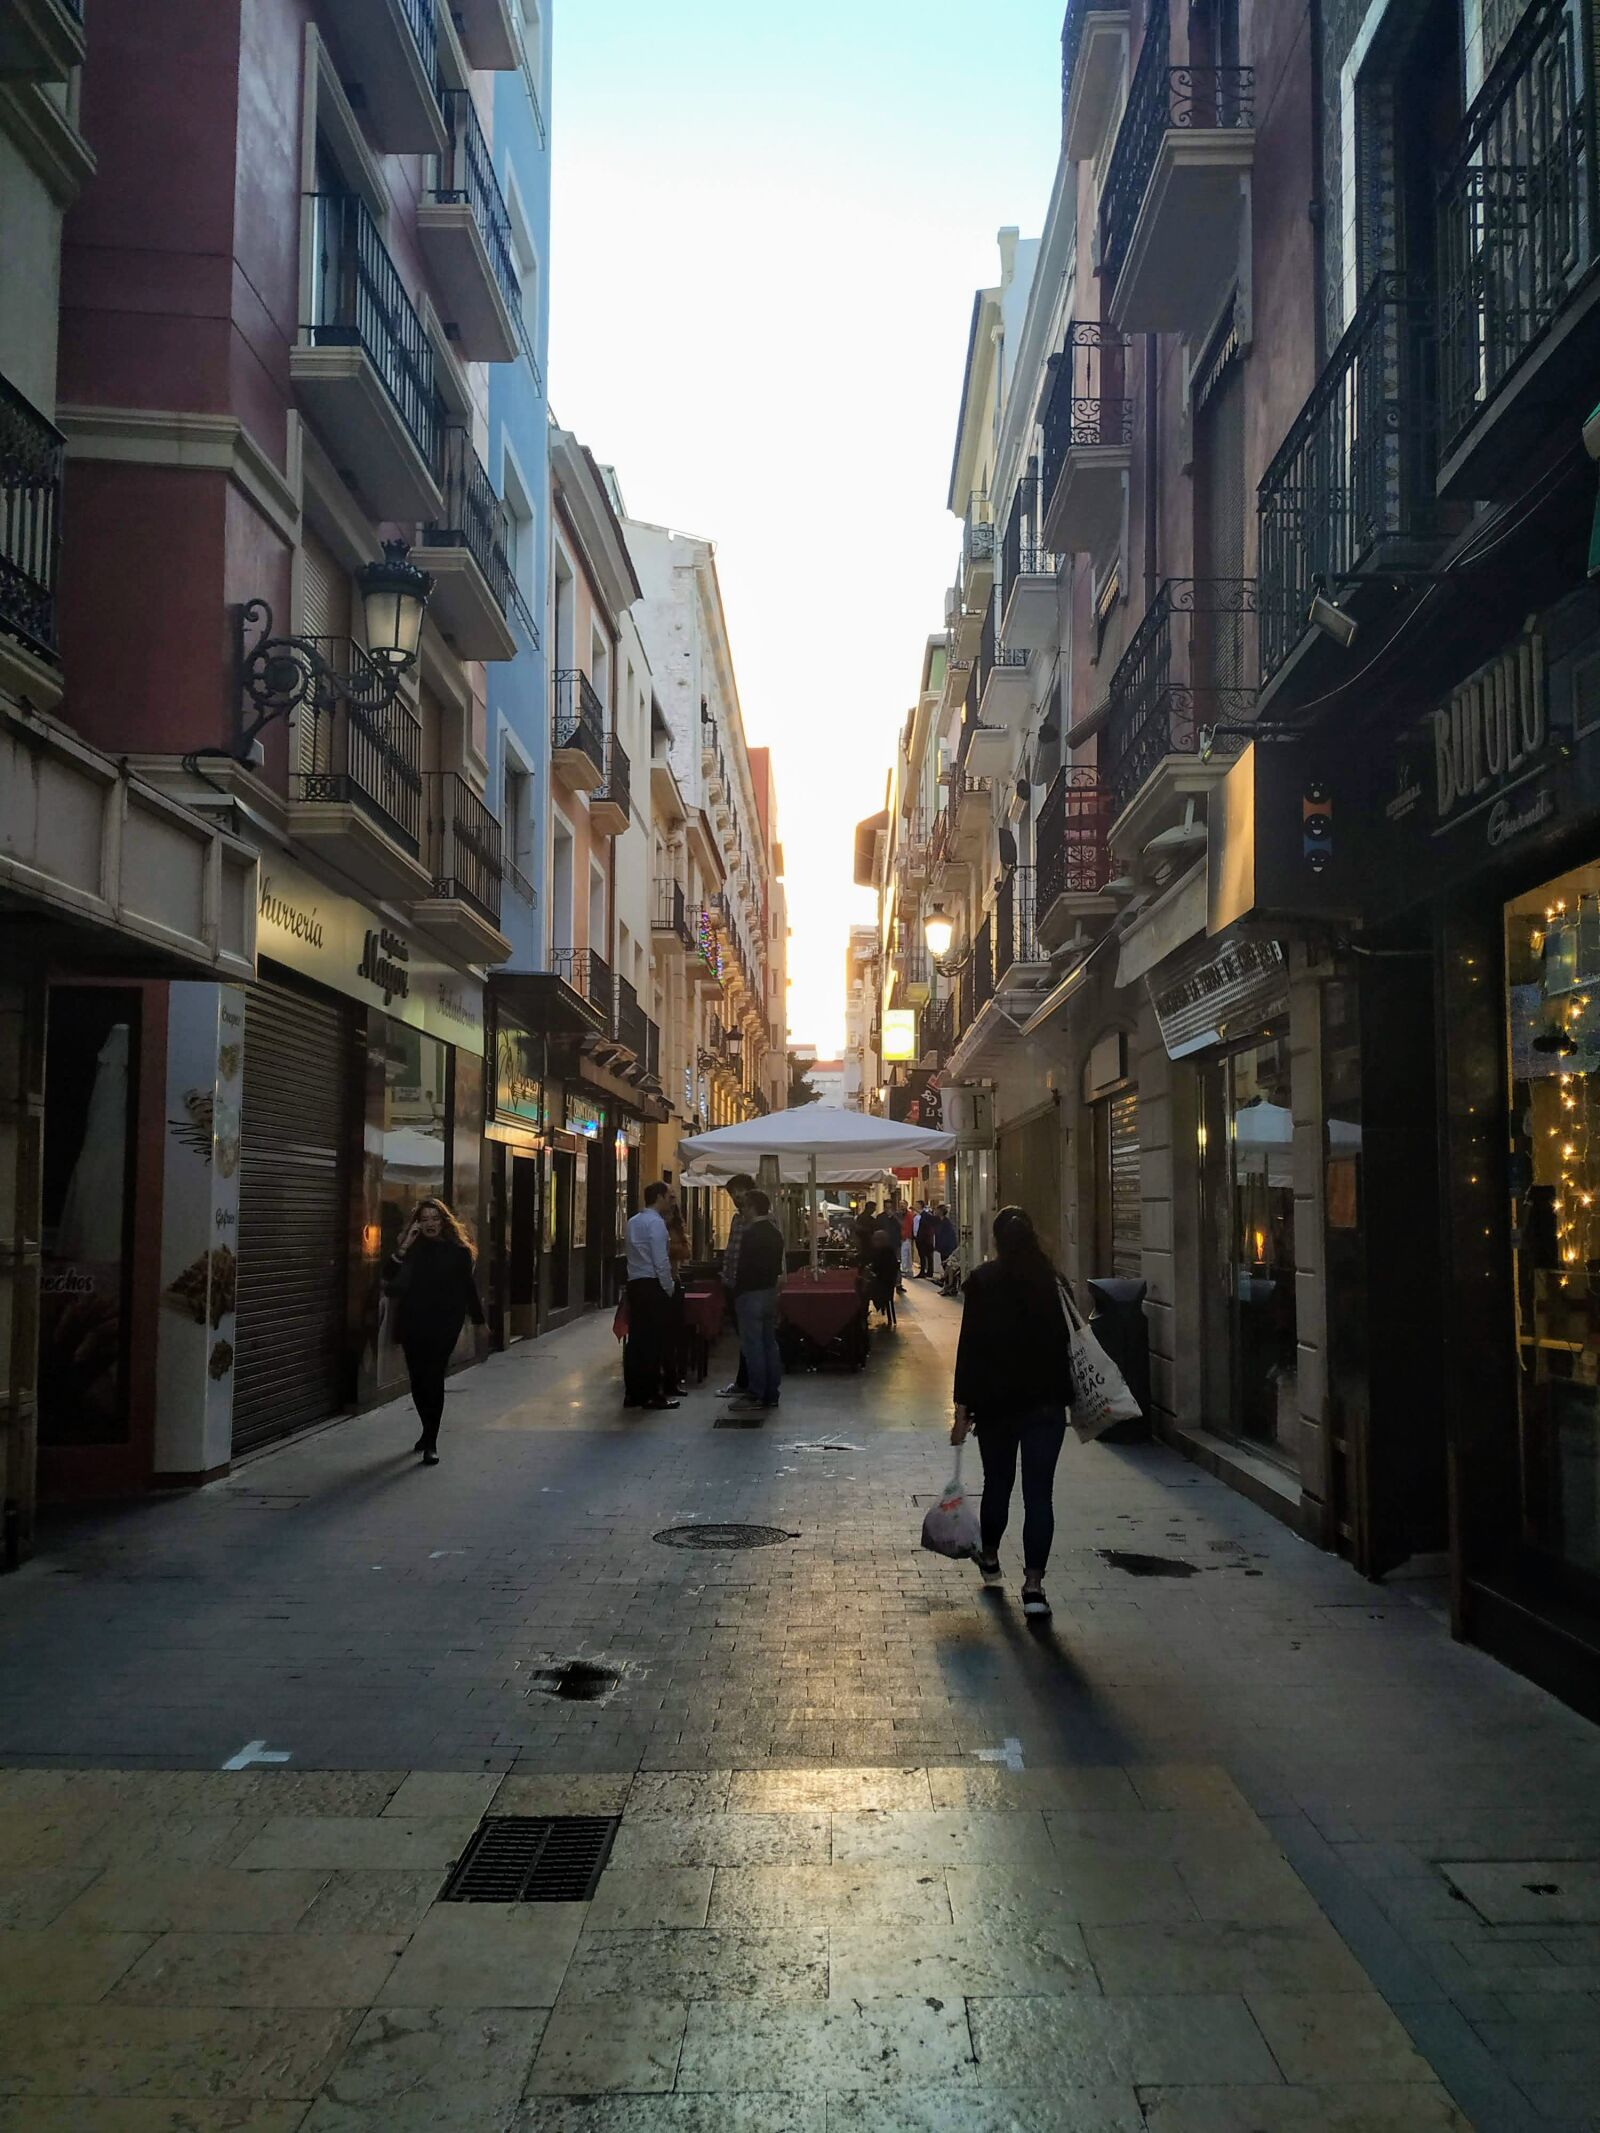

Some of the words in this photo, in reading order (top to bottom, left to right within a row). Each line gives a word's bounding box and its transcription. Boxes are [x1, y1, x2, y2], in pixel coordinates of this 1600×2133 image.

[1434, 635, 1545, 817] BULULU
[258, 872, 324, 950] hurrería
[1081, 1372, 1106, 1397] BAG
